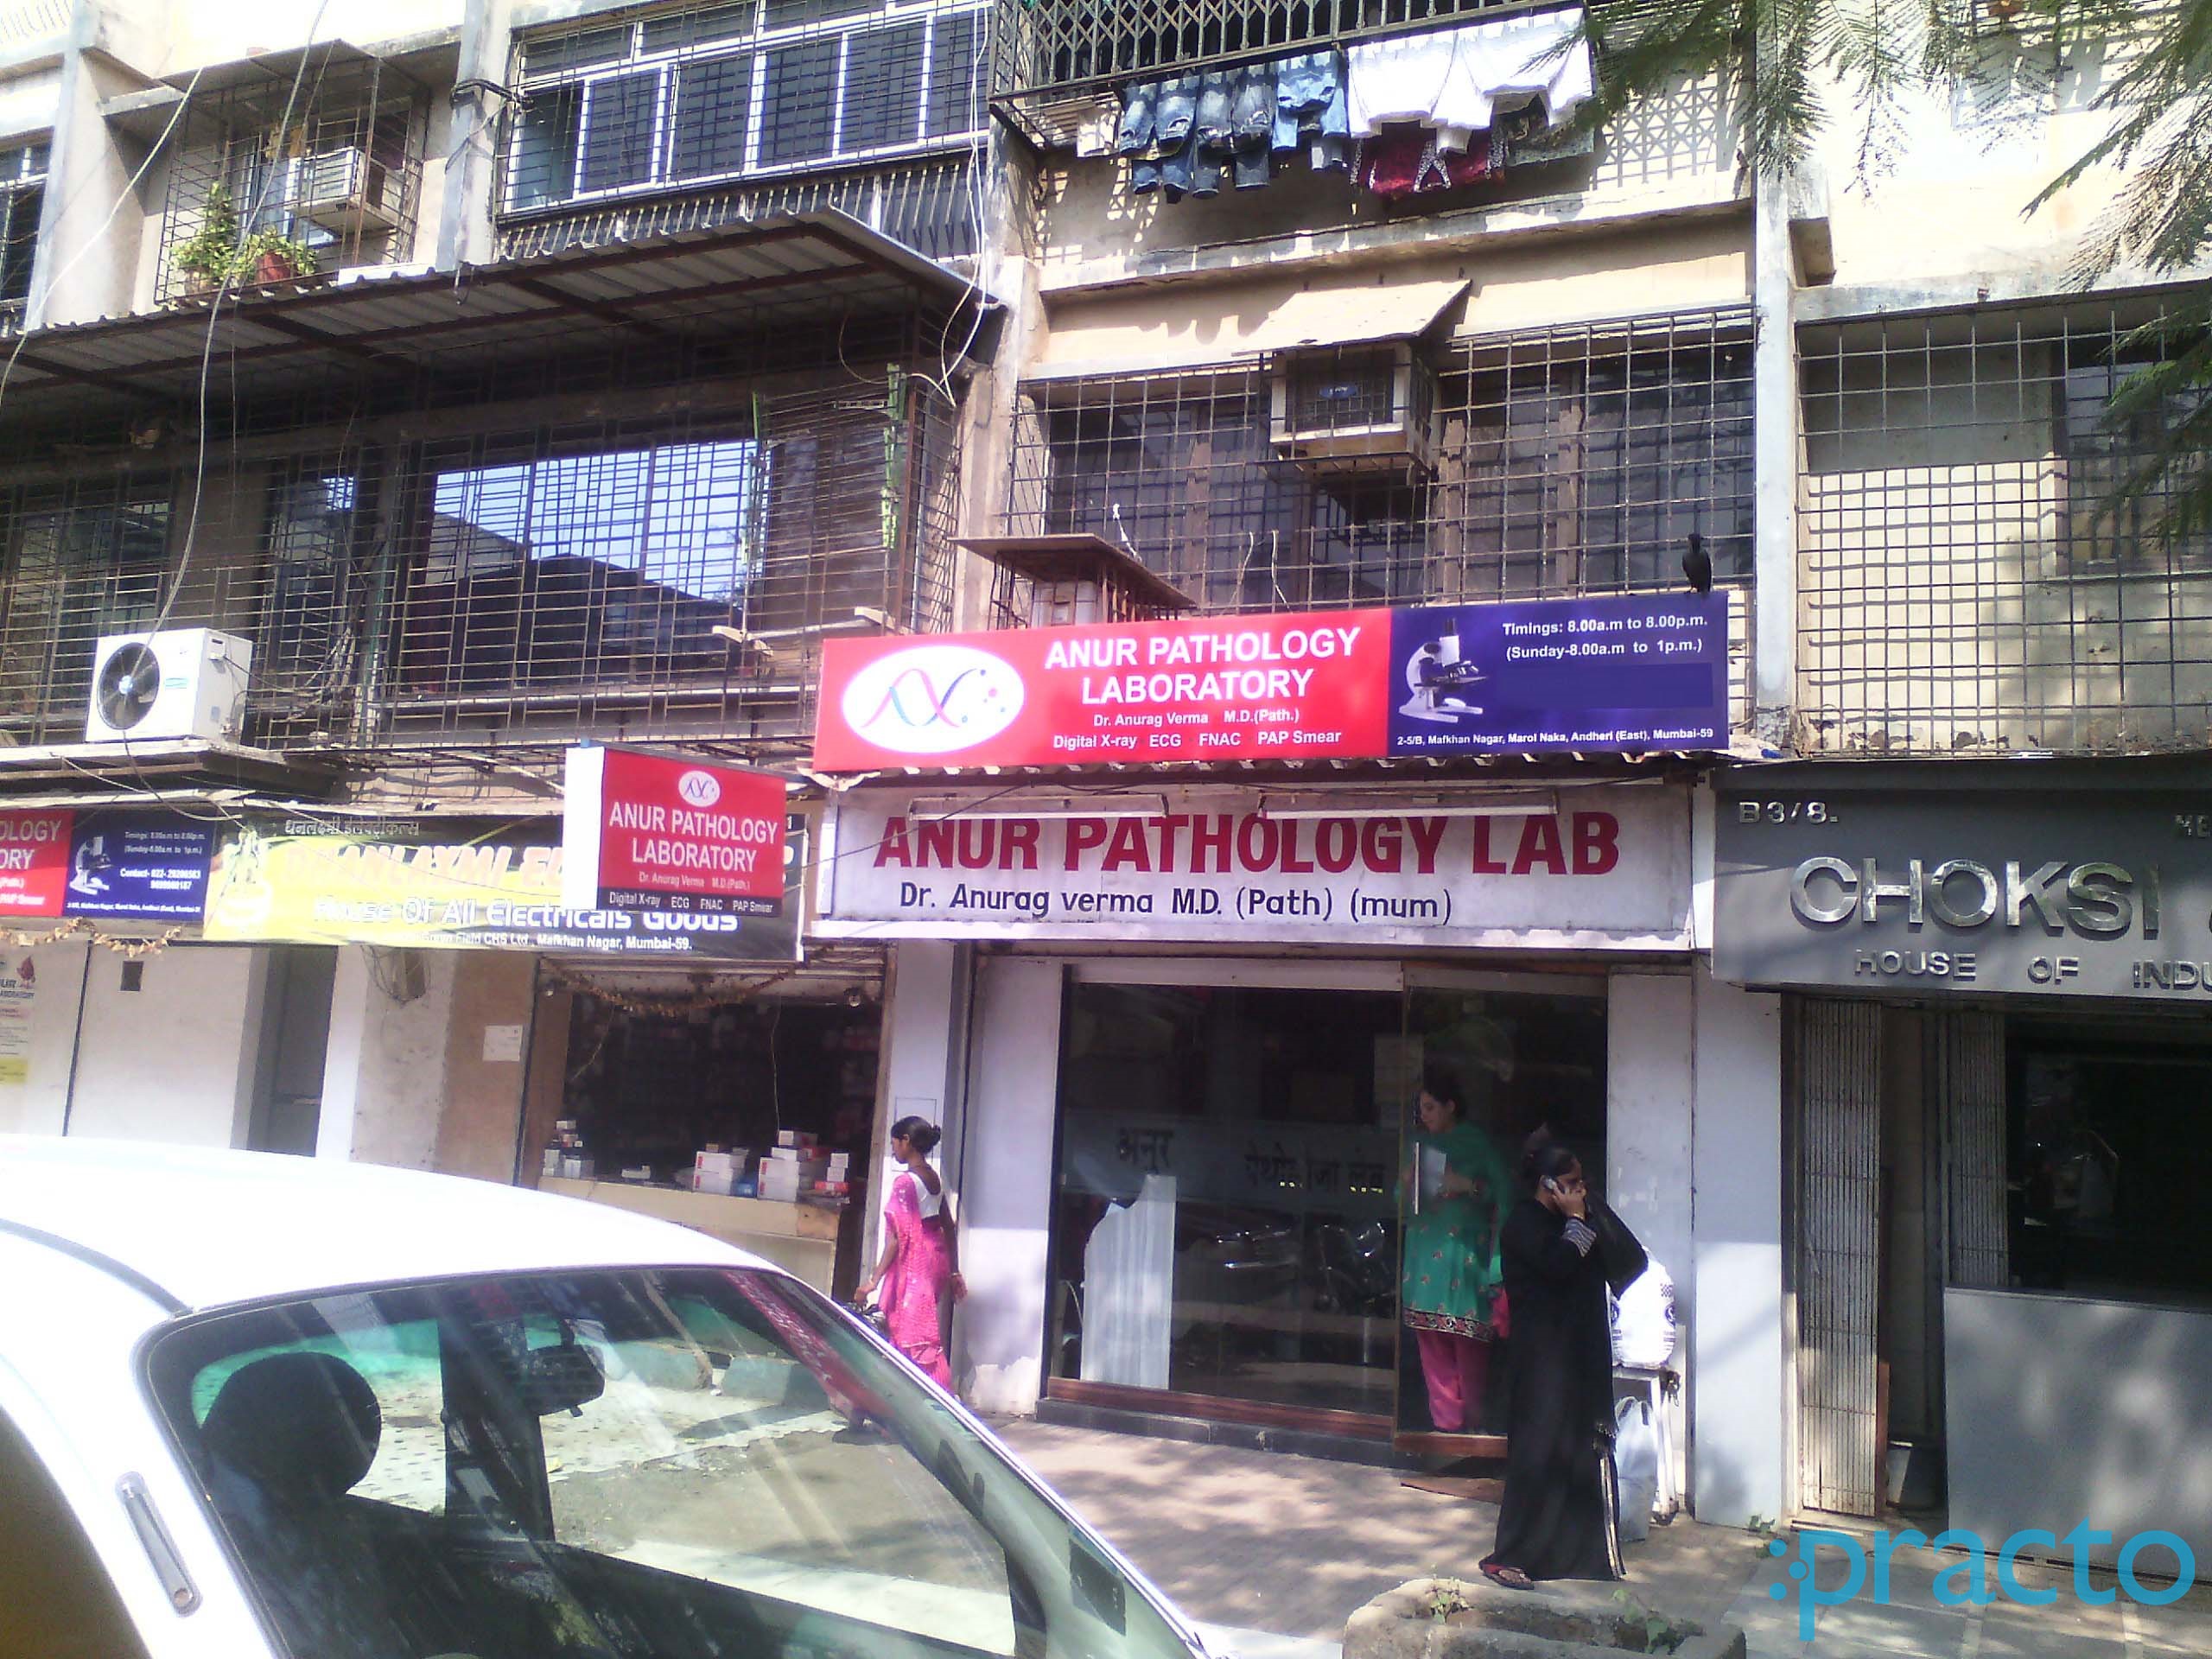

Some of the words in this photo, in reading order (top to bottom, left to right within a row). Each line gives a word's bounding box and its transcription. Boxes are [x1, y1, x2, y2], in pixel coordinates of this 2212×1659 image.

[1503, 621, 1563, 638] Timings:
[1567, 619, 1623, 632] 8.00a.m
[1627, 618, 1642, 630] to
[1645, 614, 1708, 632] 8.00p.m.
[1044, 638, 1138, 670] ANUR
[1148, 626, 1361, 665] PATHOLOGY
[1506, 642, 1625, 662] (Sunday-8.00a.m
[1633, 640, 1648, 653] to
[1657, 639, 1703, 655] 1p.m.)
[1082, 668, 1314, 704] LABORATORY
[1094, 715, 1112, 727] Dr.
[1115, 713, 1162, 728] Anurag
[1166, 711, 1209, 725] Verma
[1053, 734, 1097, 751] Digital
[1101, 734, 1137, 750] X-ray
[1149, 734, 1182, 747] ECG
[1198, 732, 1241, 747] FNAC
[1257, 731, 1288, 745] PAP
[1293, 729, 1341, 744] Smear
[1473, 733, 1506, 747] Nagar,
[1508, 731, 1537, 743] Marol
[1540, 731, 1569, 745] Naka,
[1571, 730, 1613, 742] Andheri
[1653, 728, 1713, 740] Mumbai-59
[608, 801, 665, 832] ANUR
[671, 810, 778, 844] PATHOLOGY
[632, 837, 757, 873] LABORATORY
[873, 815, 1041, 870] ANUR
[1065, 813, 1449, 874] PATHOLOGY
[1472, 811, 1620, 876] LAB
[652, 872, 680, 888] Anurag
[1790, 856, 2160, 939] CHOKSI
[402, 896, 435, 925] Of
[442, 898, 475, 925] All
[486, 899, 632, 931] Electricals
[609, 892, 637, 906] Digital
[639, 894, 661, 907] X-ray
[671, 896, 690, 909] ECG
[700, 898, 723, 911] FNAC
[733, 899, 747, 912] PAP
[900, 882, 936, 908] Dr.
[950, 883, 1049, 918] Anurag
[1060, 891, 1154, 914] verma
[1172, 887, 1222, 915] M.D.
[1236, 887, 1332, 921] (Path)
[1351, 888, 1452, 925] (mum)
[588, 934, 623, 950] Nagar,
[1854, 949, 1976, 982] HOUSE
[2027, 956, 2079, 985] OF
